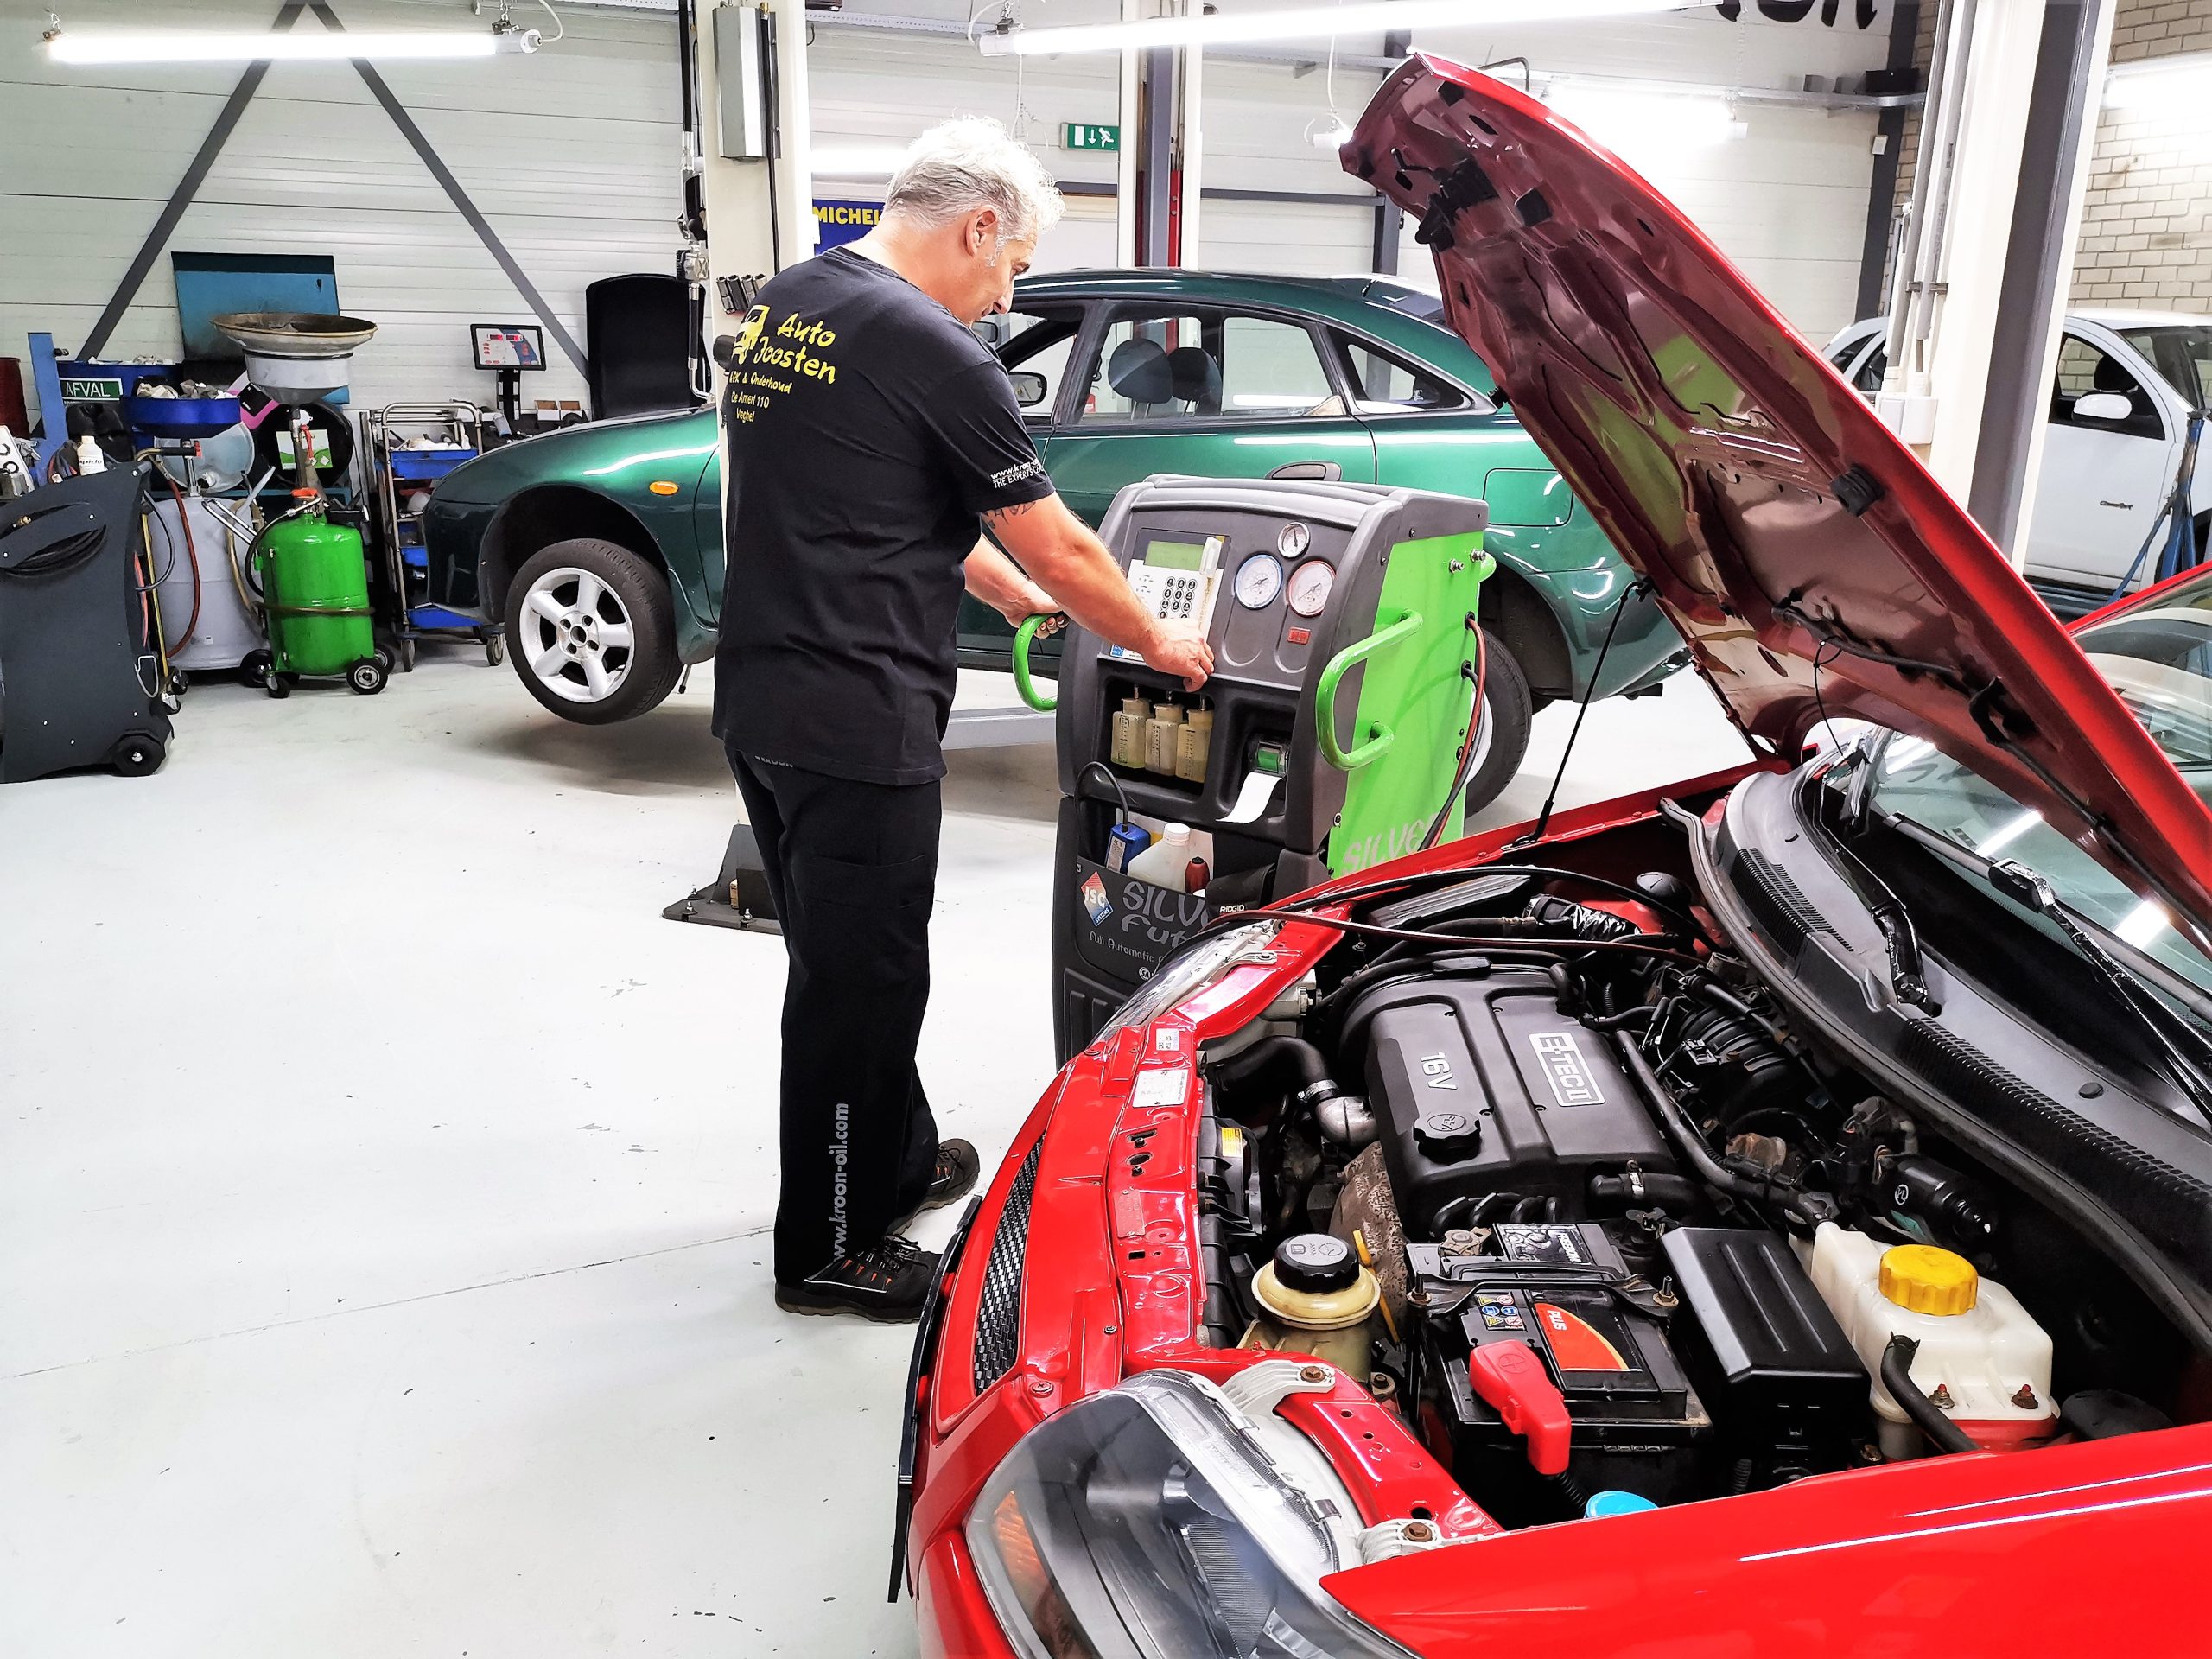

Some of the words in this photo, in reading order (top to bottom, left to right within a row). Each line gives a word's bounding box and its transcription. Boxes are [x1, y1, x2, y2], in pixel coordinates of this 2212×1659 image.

[777, 312, 836, 348] Auto
[753, 336, 836, 385] Joosten
[66, 382, 111, 397] AFVAL
[750, 372, 793, 395] Onderhoud
[757, 395, 770, 410] 110
[736, 407, 755, 423] Veghel
[992, 477, 1007, 489] THE
[1095, 907, 1109, 924] SYSTEMS
[1219, 904, 1245, 913] RIDGID
[1108, 938, 1154, 963] Automatic
[1420, 1052, 1458, 1090] 16V
[1547, 1309, 1567, 1331] PLUS
